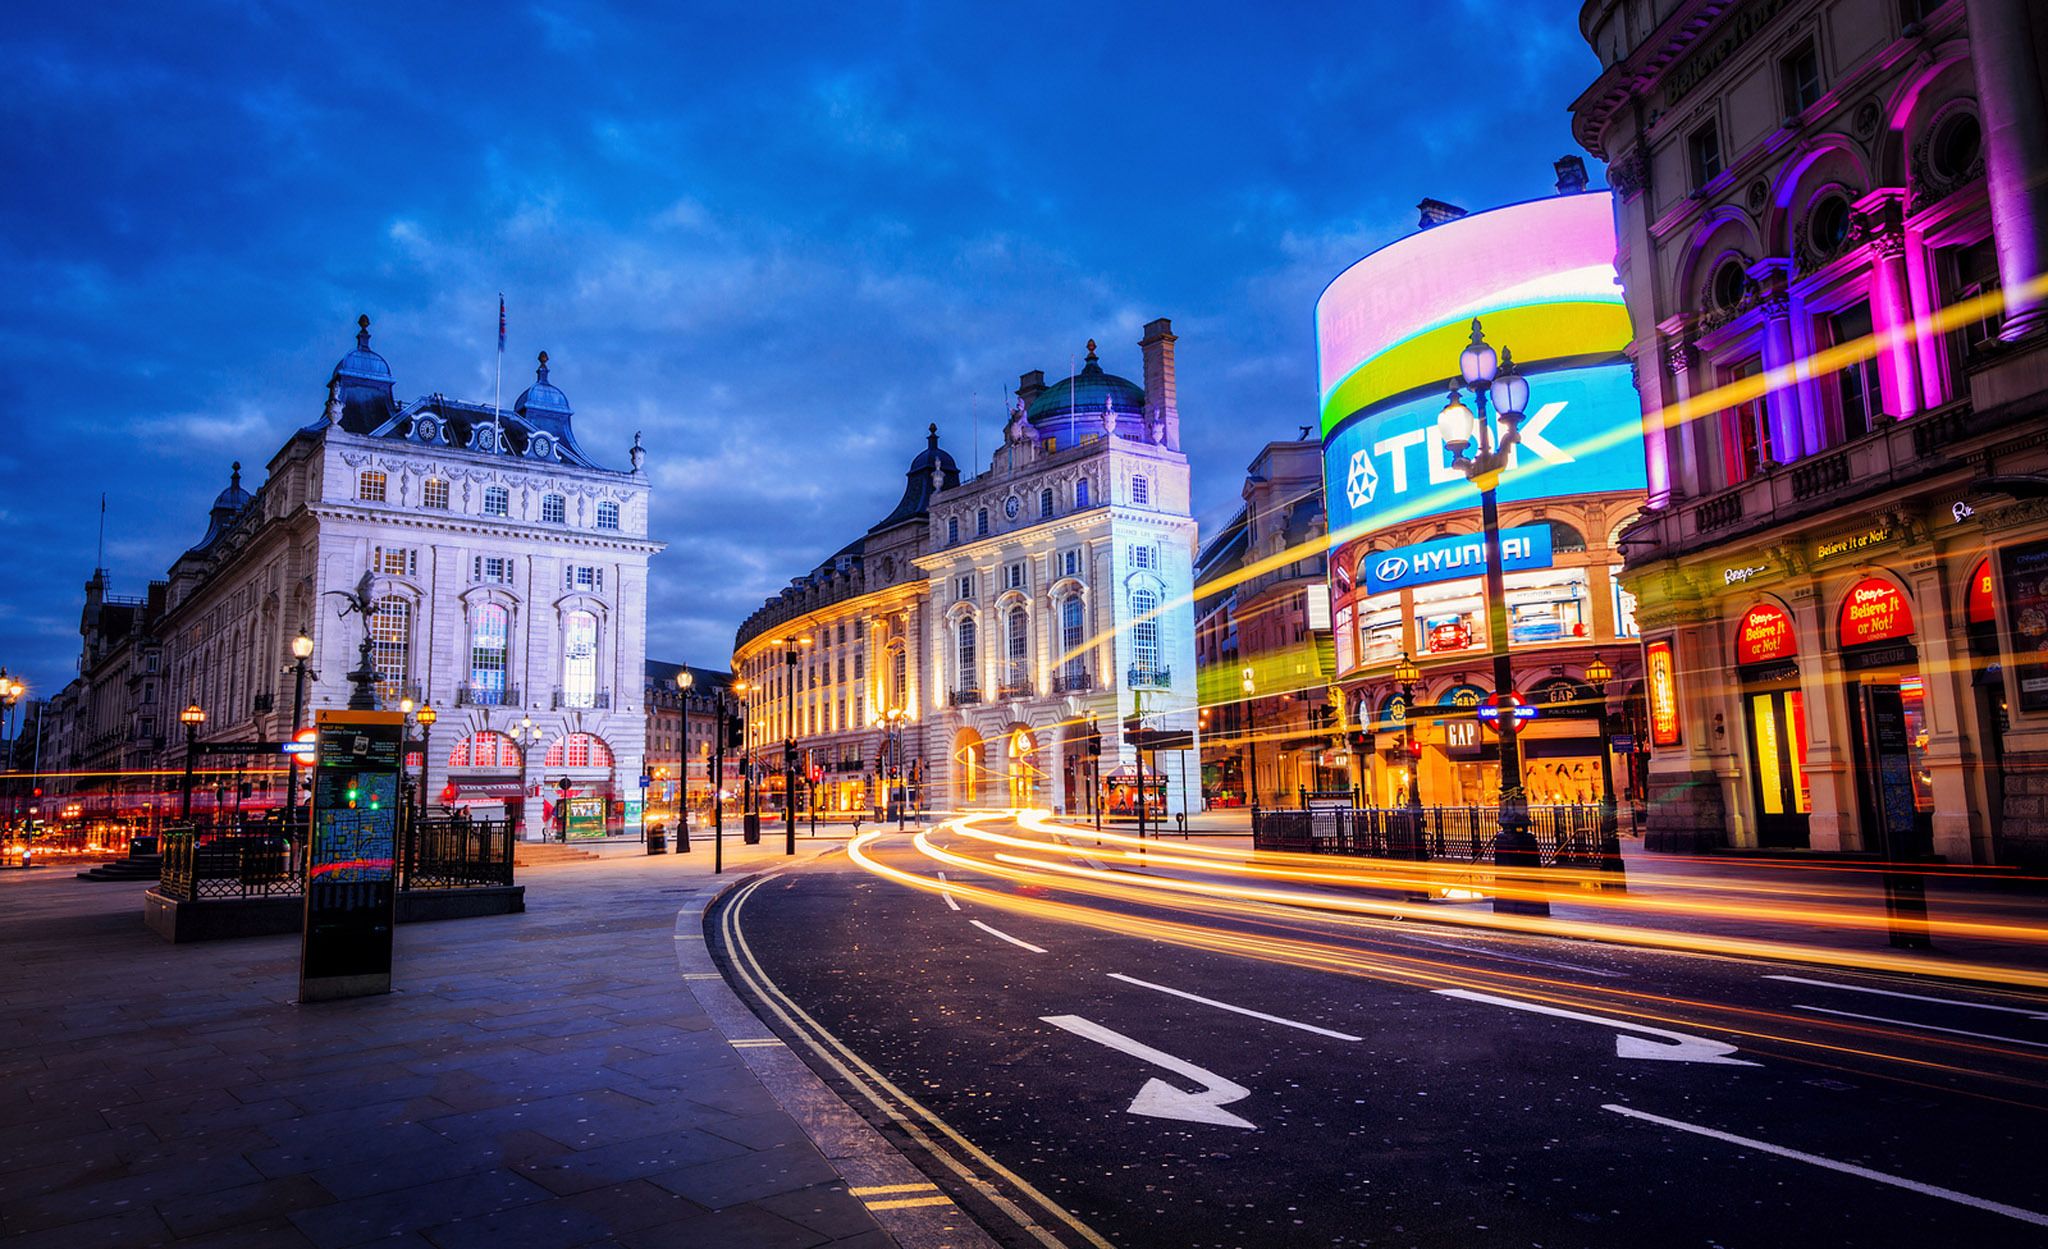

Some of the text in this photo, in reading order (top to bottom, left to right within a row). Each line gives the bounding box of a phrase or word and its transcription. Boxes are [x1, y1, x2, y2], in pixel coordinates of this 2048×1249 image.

[1374, 401, 1576, 494] TDK
[1818, 540, 1848, 559] Believe
[1869, 529, 1888, 544] Not!
[1413, 538, 1531, 575] HYUNAI
[1850, 596, 1900, 620] Believe It
[1745, 620, 1785, 641] Believe It
[1857, 614, 1894, 635] or Not!
[1751, 636, 1781, 654] or Not!
[1456, 696, 1476, 706] GAP
[1550, 689, 1573, 703] GAP
[1448, 723, 1474, 746] GAP
